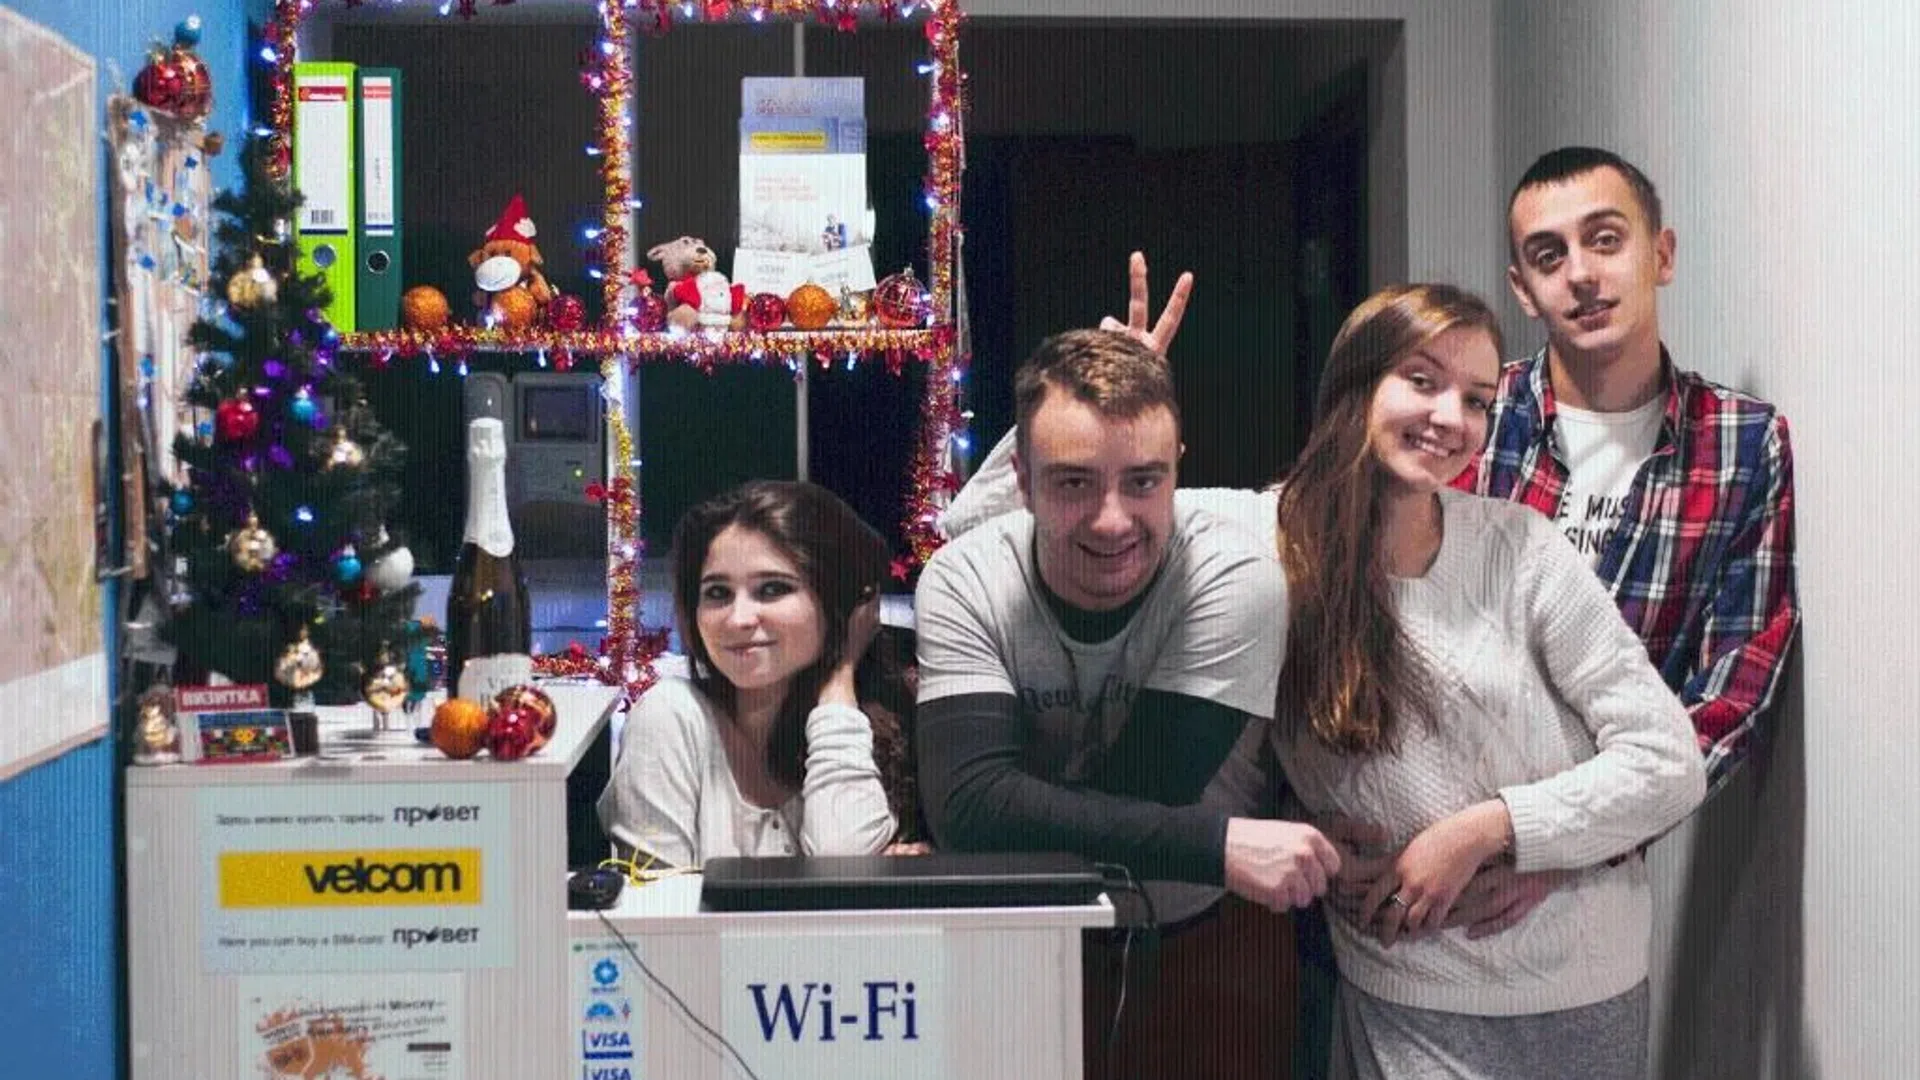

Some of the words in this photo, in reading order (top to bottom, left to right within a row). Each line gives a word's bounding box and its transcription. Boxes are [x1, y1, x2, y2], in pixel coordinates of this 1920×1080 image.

[182, 689, 261, 706] ВИЗИТКА
[304, 858, 461, 893] velcom
[747, 981, 919, 1042] Wi-Fi
[590, 1031, 631, 1048] VISA
